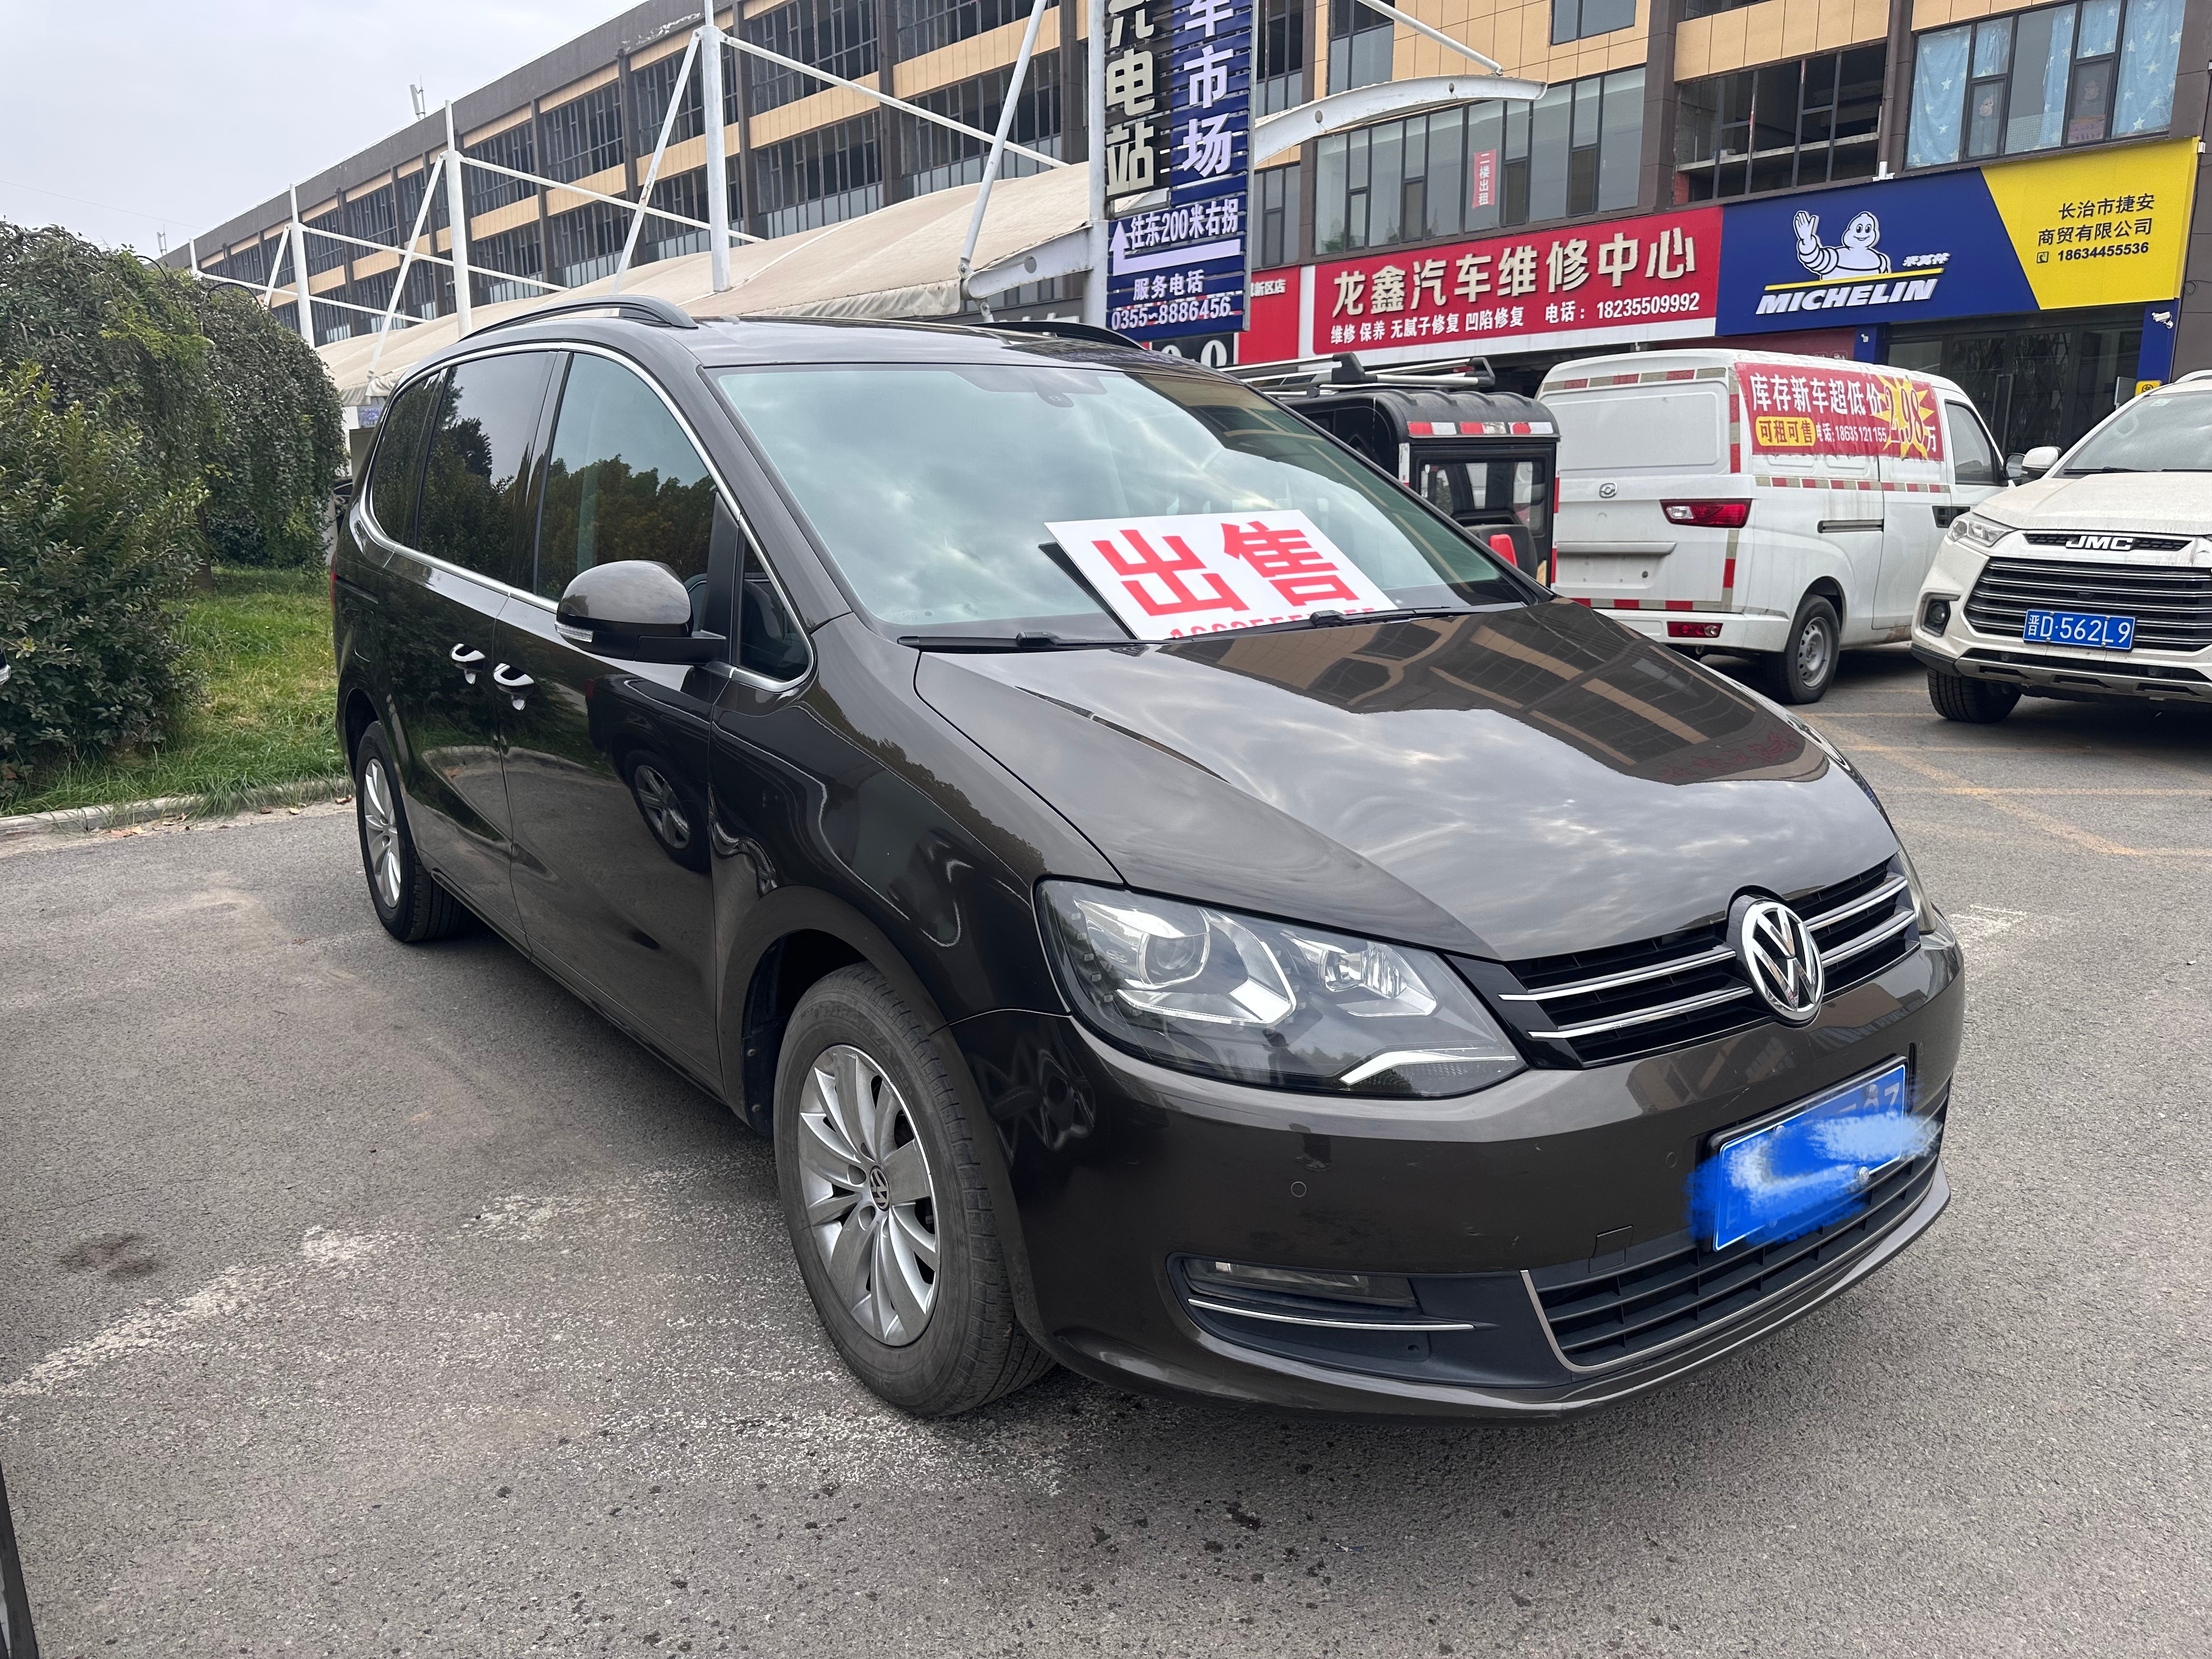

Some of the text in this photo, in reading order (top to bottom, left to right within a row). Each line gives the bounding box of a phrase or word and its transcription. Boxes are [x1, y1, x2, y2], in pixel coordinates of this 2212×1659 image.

[1479, 153, 1489, 205] 二楼出租
[2058, 193, 2154, 219] 长治市捷安
[1130, 198, 1239, 250] 往东200米右拐
[2038, 218, 2152, 246] 商贸有限公司
[2058, 242, 2149, 261] 18634455536
[1133, 269, 1204, 301] 服务电话
[1332, 227, 1695, 318] 龙鑫汽车维修中心
[1755, 279, 1938, 314] MICHELIN
[1330, 324, 1355, 345] 维修
[1359, 320, 1385, 342] 保养
[1390, 313, 1459, 339] 无腻子修复
[1465, 306, 1524, 332] 凹陷修复
[1596, 292, 1700, 319] 18235509992
[1750, 372, 1883, 417] 库存新车超低价
[1759, 419, 1813, 444] 可租可售
[2065, 535, 2134, 550] JMC
[1091, 520, 1360, 617] 出售
